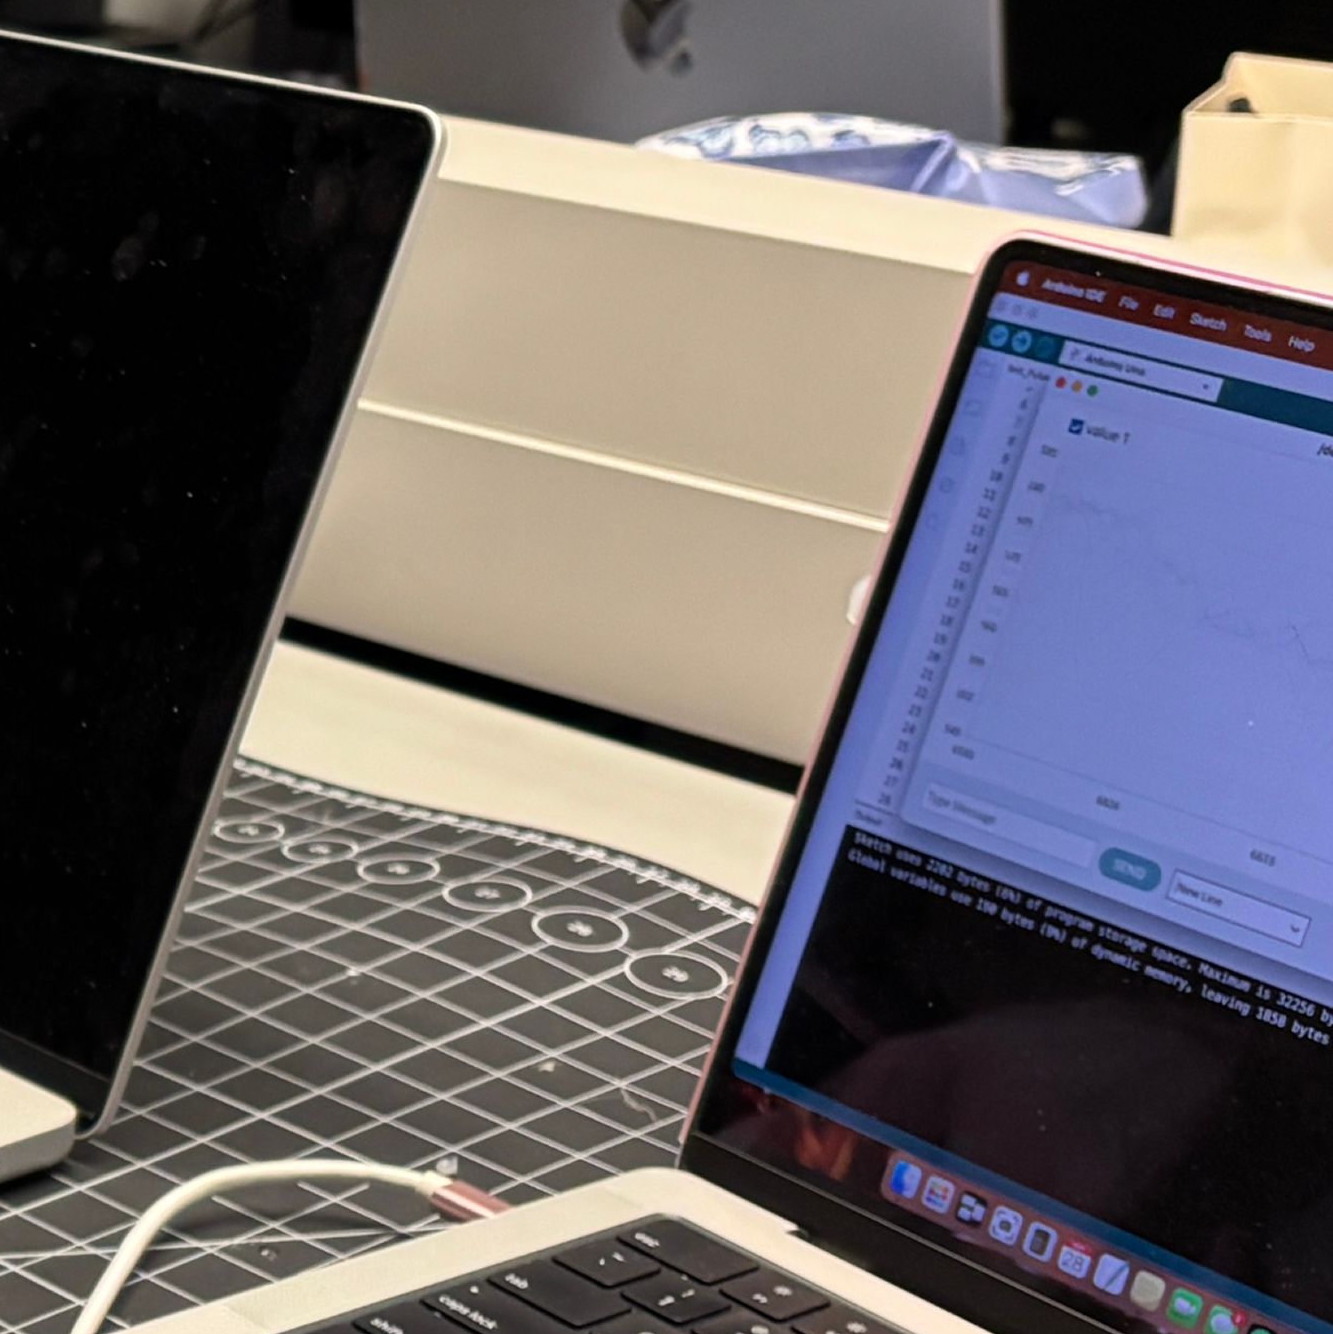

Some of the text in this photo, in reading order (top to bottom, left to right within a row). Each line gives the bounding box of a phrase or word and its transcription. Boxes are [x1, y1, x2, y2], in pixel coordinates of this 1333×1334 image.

[1119, 295, 1139, 311] File
[1153, 304, 1176, 319] Edit
[1190, 312, 1227, 332] Sketch
[1244, 324, 1272, 342] Tools
[1288, 335, 1316, 353] Help
[1177, 882, 1223, 907] New Line
[890, 865, 947, 897] variables
[1071, 936, 1088, 950] of
[1090, 943, 1141, 972] dynamic
[1201, 983, 1251, 1017] leaving
[1291, 1021, 1330, 1046] bytes
[1098, 925, 1148, 954] storage
[1199, 962, 1252, 993] Maximum
[1255, 985, 1271, 1001] is
[1276, 993, 1315, 1018] 32256
[505, 1271, 530, 1291] tab
[1060, 1251, 1083, 1273] 28
[438, 1293, 499, 1332] caps lock
